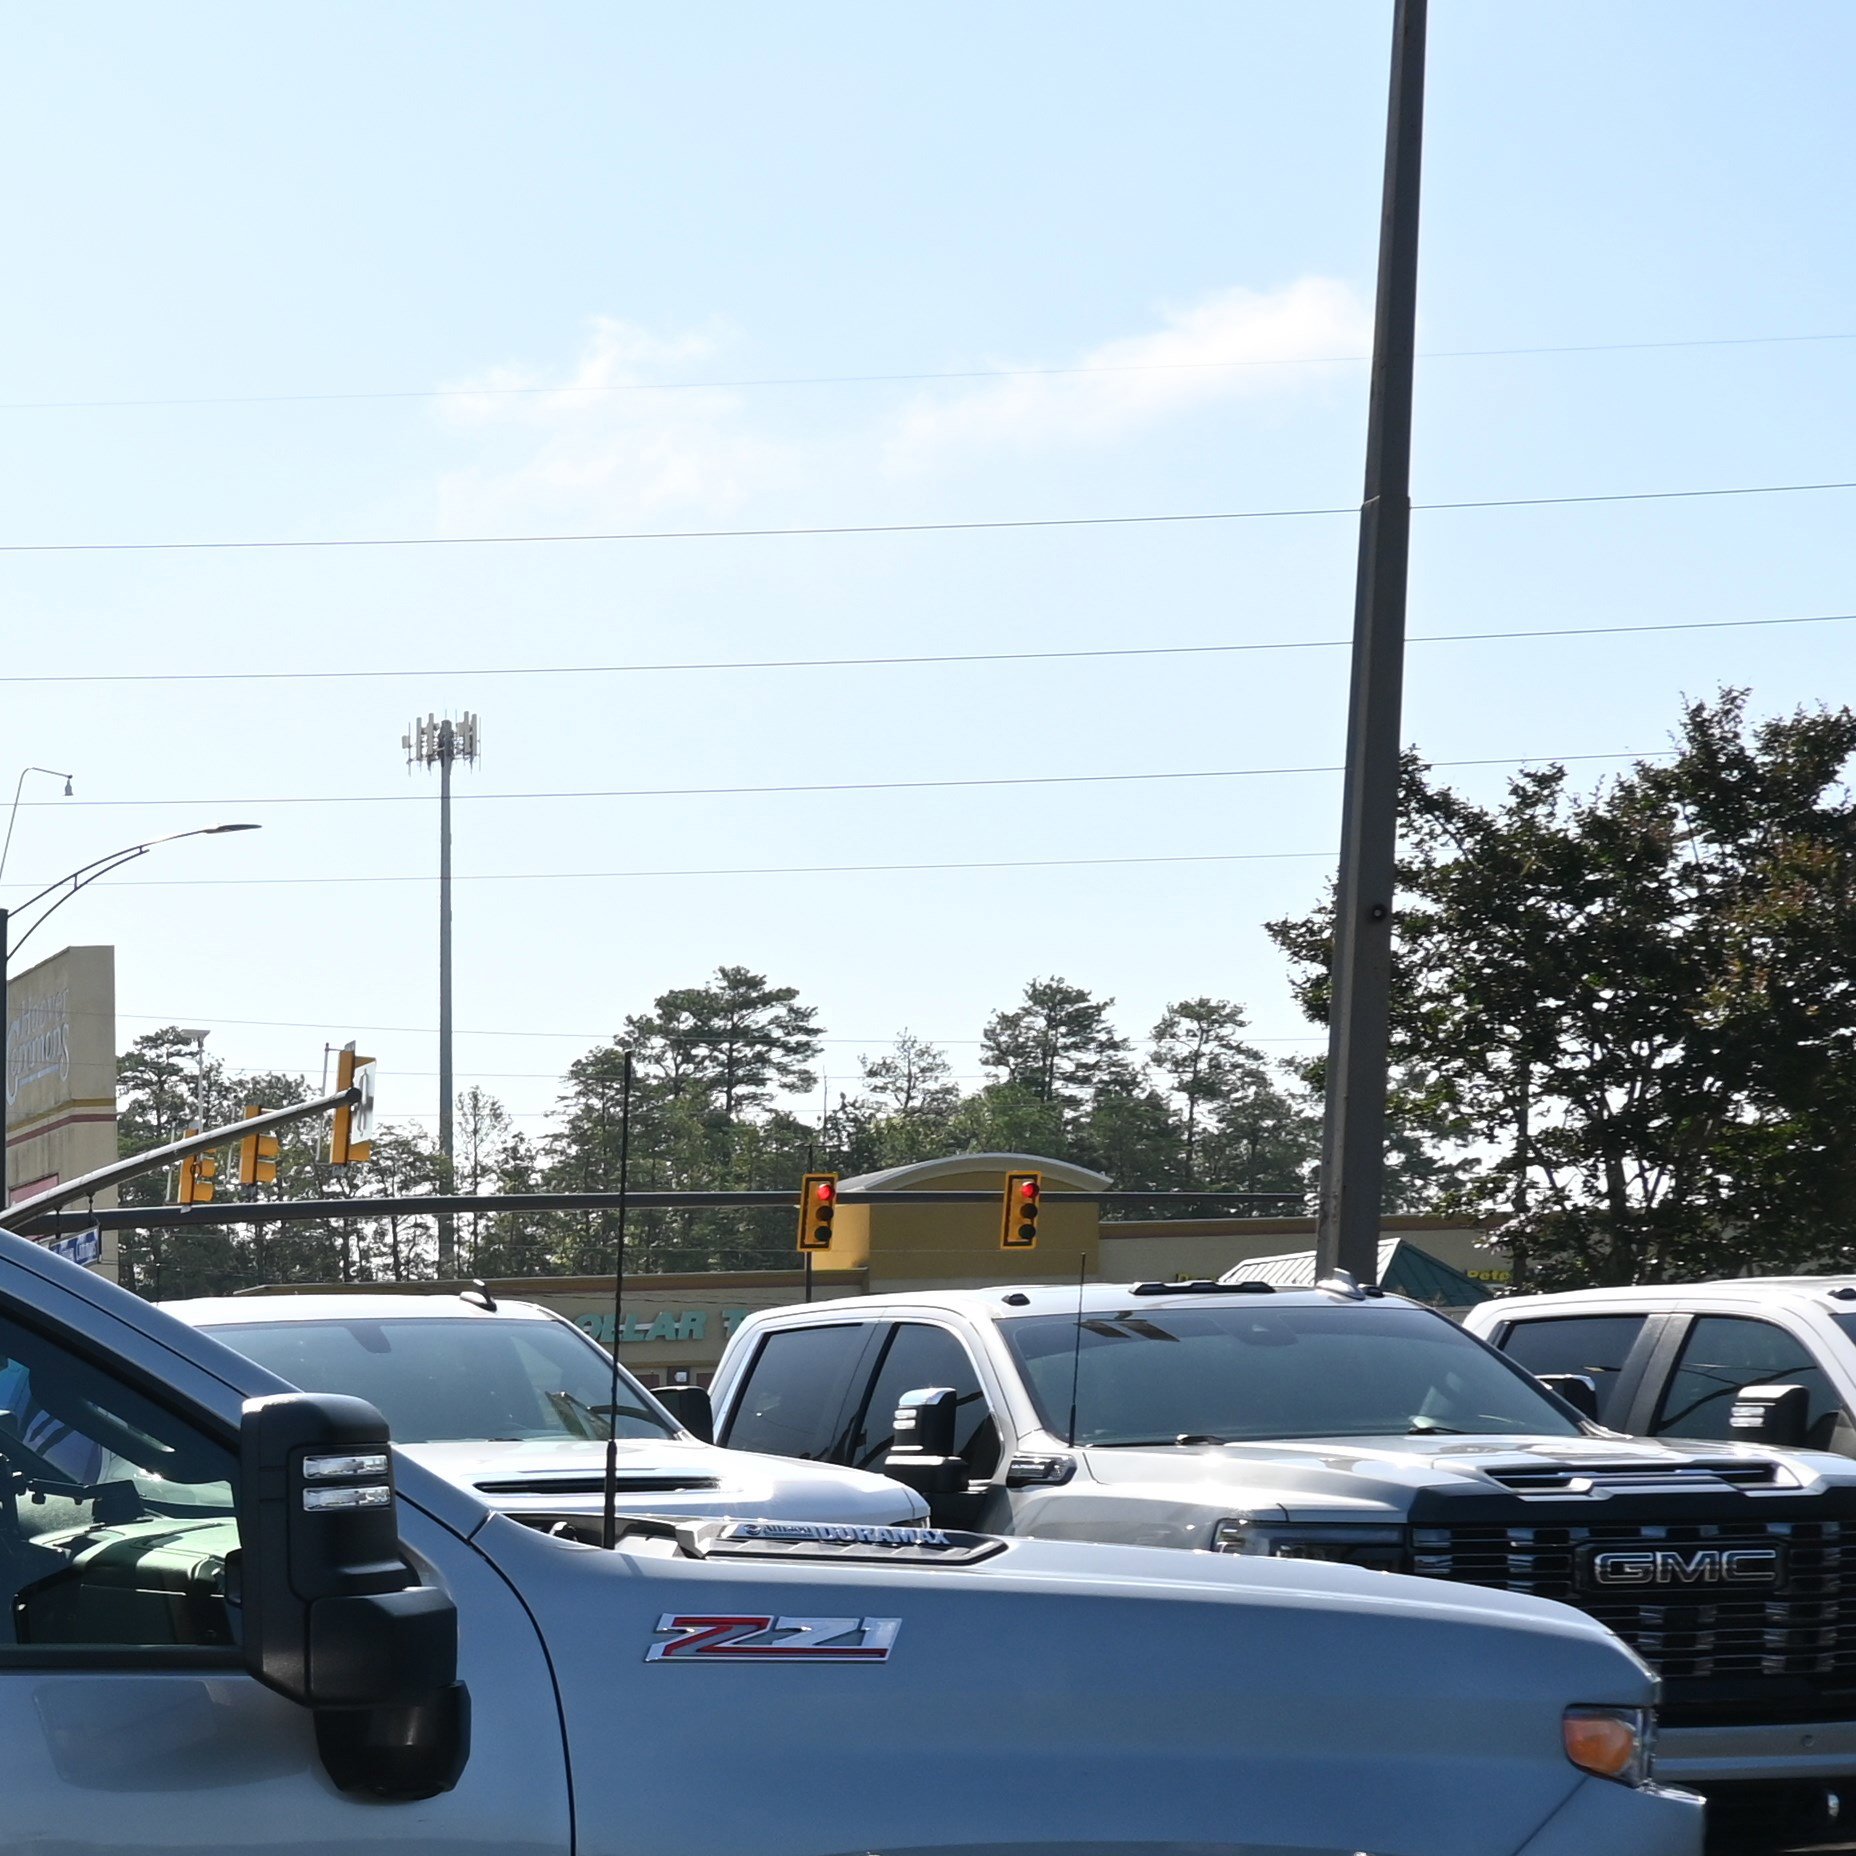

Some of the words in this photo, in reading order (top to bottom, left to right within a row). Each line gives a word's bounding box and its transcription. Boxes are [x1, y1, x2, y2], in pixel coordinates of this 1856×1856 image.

[574, 1311, 708, 1344] OLLAR
[821, 1526, 951, 1545] DURAMAX
[1594, 1550, 1777, 1584] GMC
[643, 1613, 903, 1662] Z71
